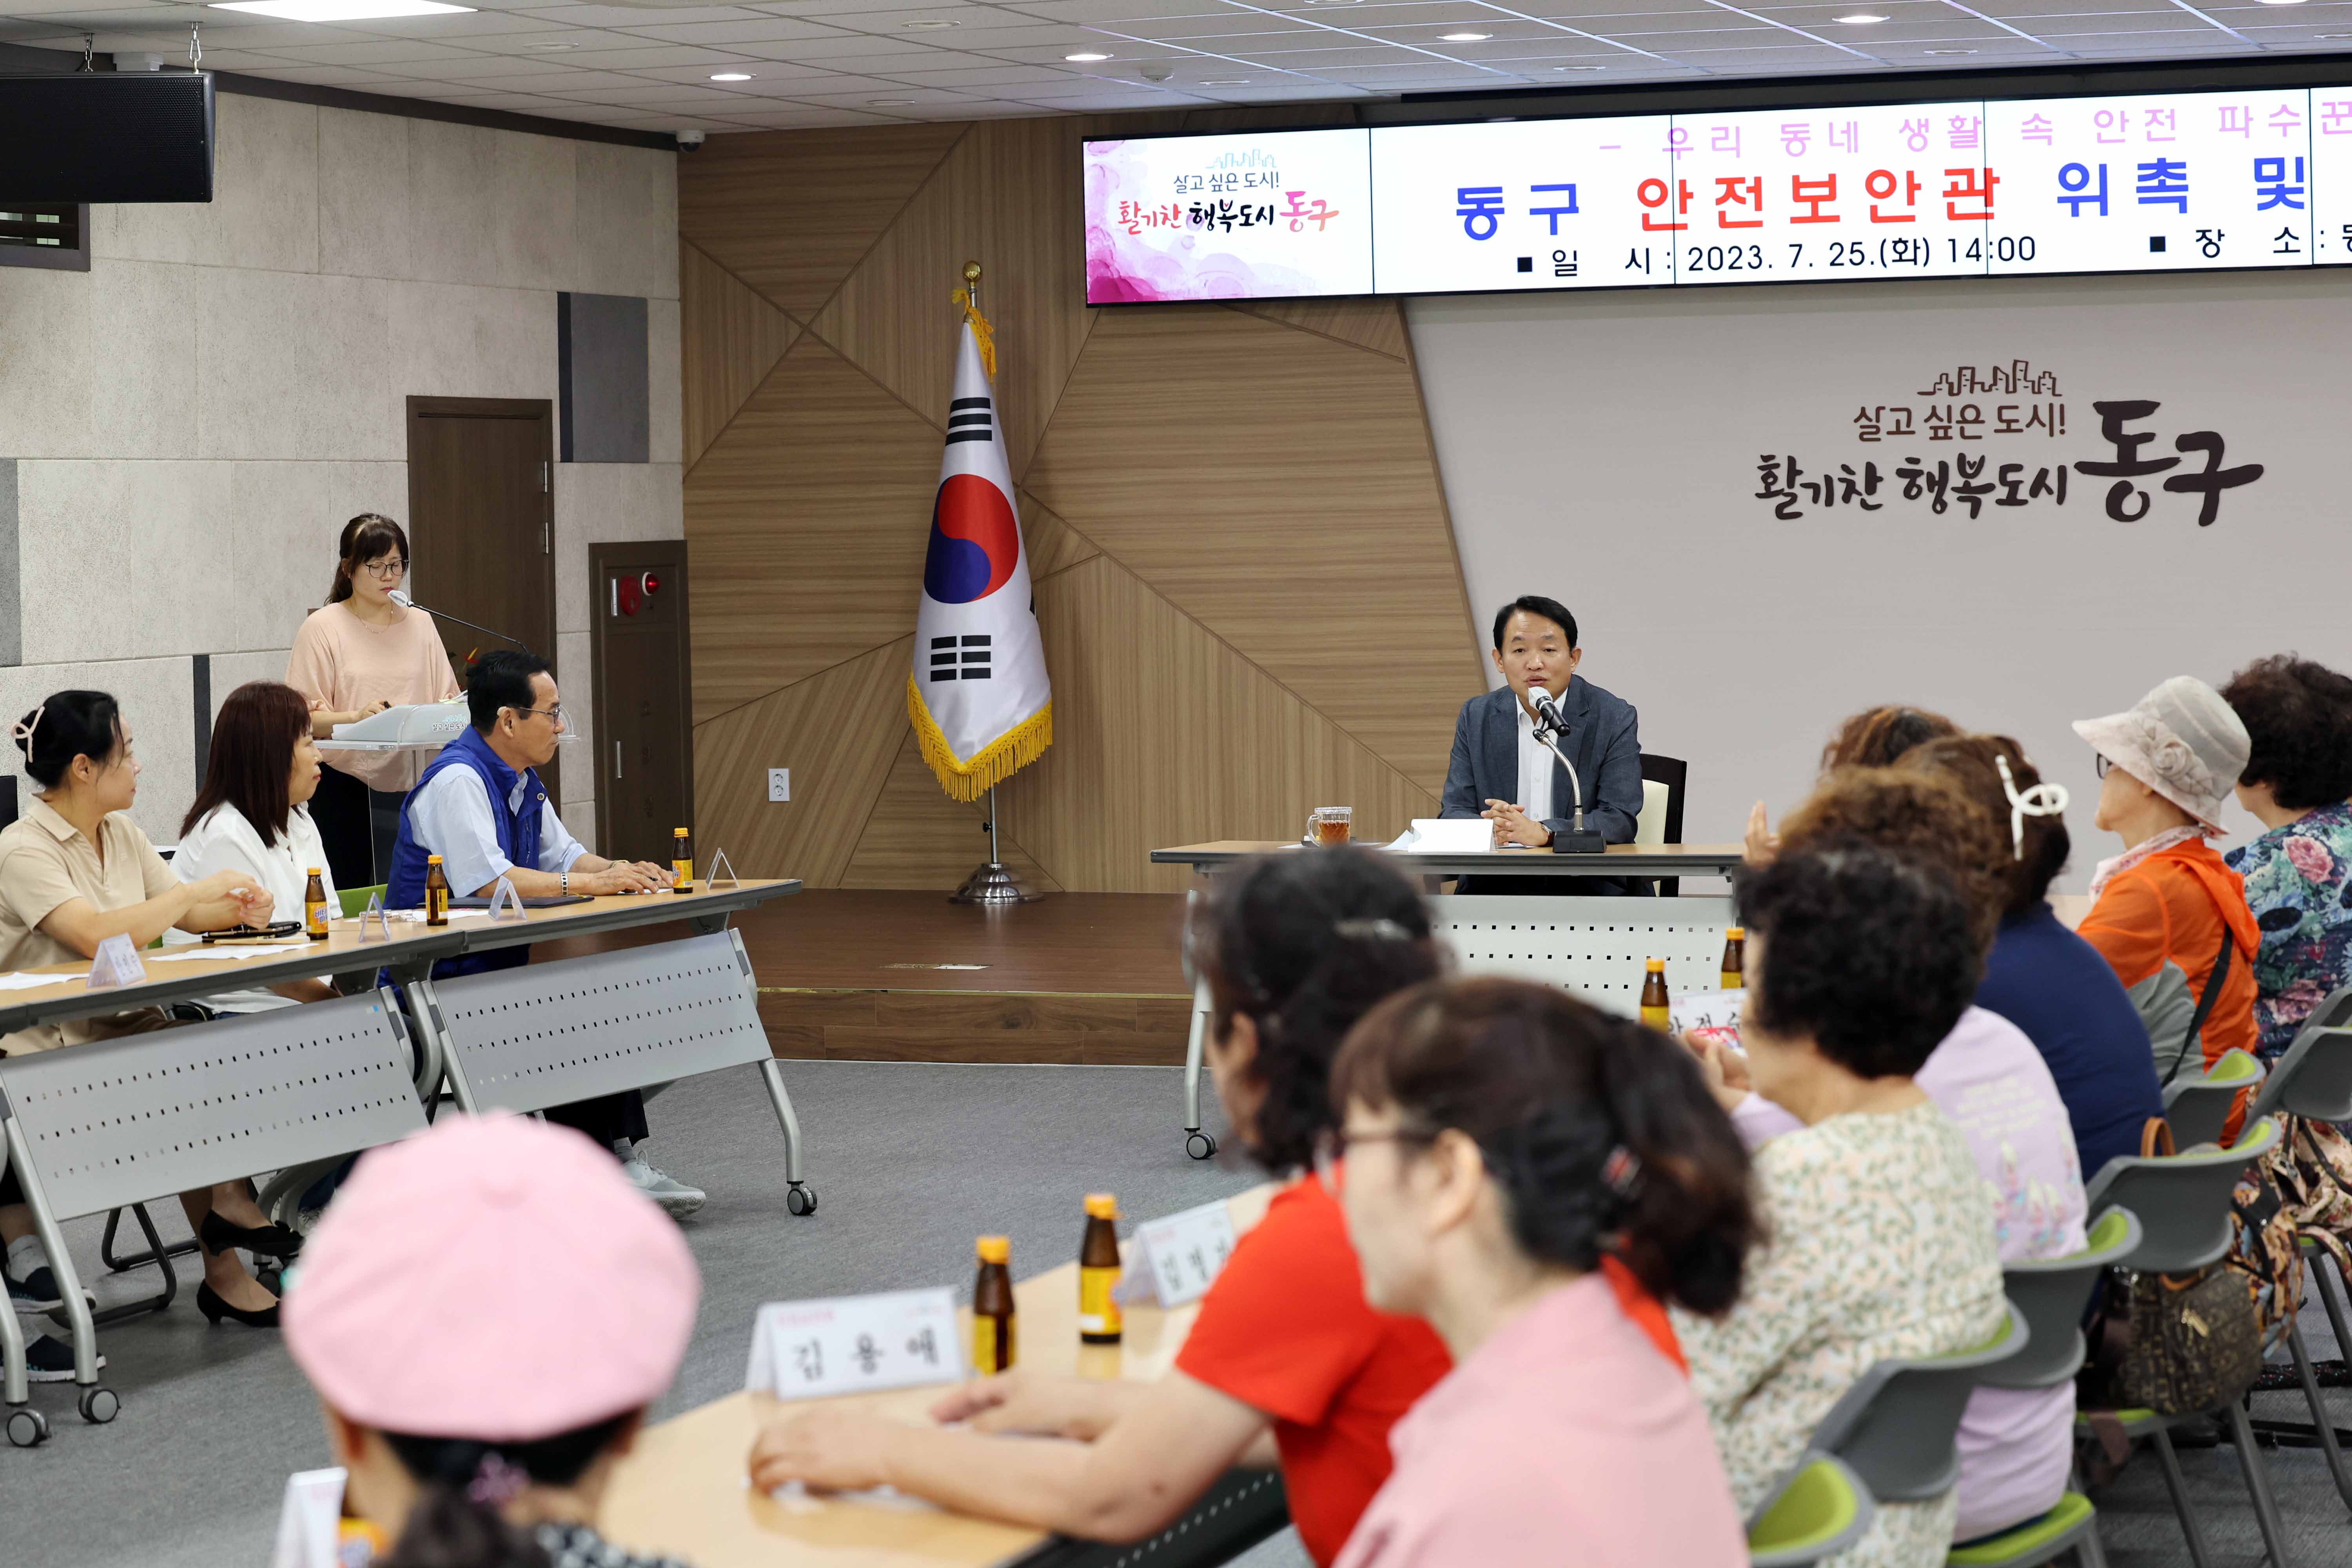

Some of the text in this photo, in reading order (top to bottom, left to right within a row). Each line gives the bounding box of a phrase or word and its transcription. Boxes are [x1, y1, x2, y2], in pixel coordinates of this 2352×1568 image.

[1662, 126, 1740, 160] 우리
[1781, 121, 1858, 157] 동네
[1900, 115, 1982, 152] 생활
[2021, 113, 2053, 145] 속
[2094, 109, 2176, 143] 안전
[2220, 101, 2352, 138] 파수꾼
[1174, 171, 1279, 194] 살고 싶은 도시!
[1456, 156, 2305, 241] 동구 안전보안관 위촉 및
[1118, 191, 1339, 235] 활기찬 행복도시 동구
[1688, 245, 1772, 271] 2023.
[1789, 244, 1813, 268] 7.
[1829, 237, 1929, 268] 25.(화)
[1948, 236, 2035, 263] 14:00
[1853, 403, 2065, 442] 살고 싶은 도시!
[1755, 400, 2264, 527] 활기찬 행복도시 동구
